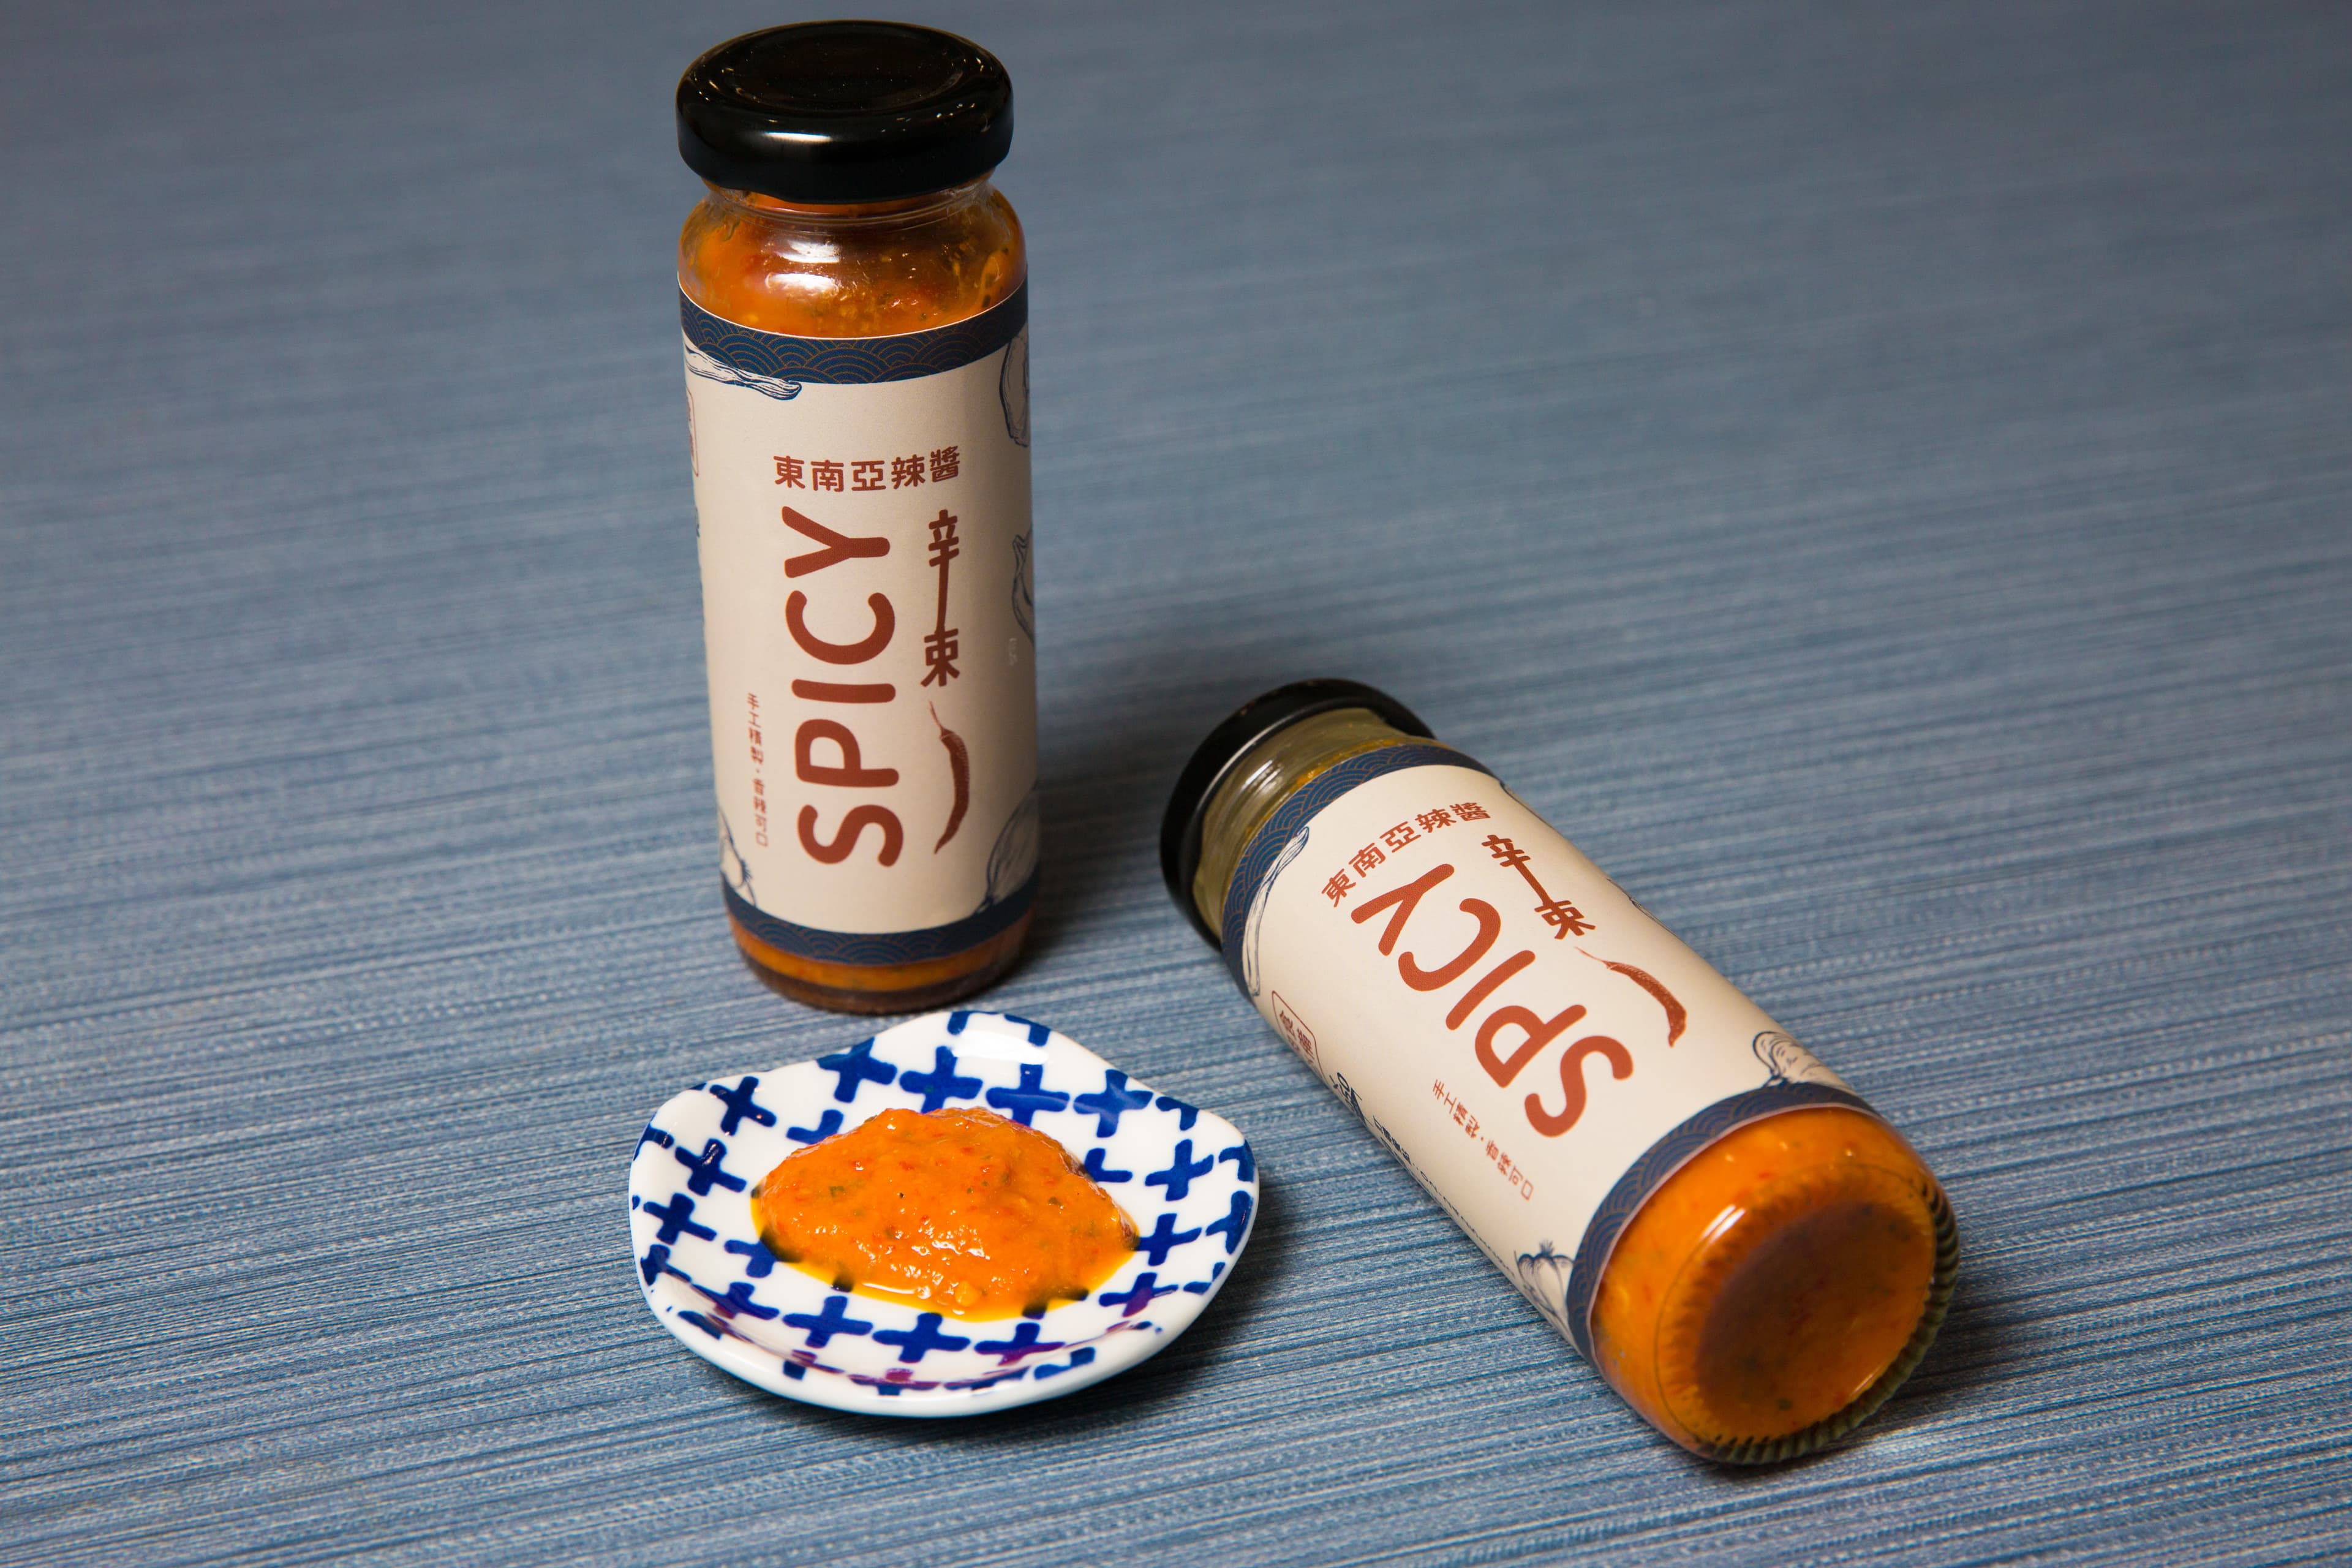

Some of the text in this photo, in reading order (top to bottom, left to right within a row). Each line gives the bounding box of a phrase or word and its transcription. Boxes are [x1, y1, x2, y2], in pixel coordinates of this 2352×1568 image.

[773, 445, 960, 492] 東南亞辣醬
[781, 505, 904, 868] SPICY
[1321, 802, 1491, 908] 東南亞辣醬
[1350, 863, 1634, 1138] SPICY
